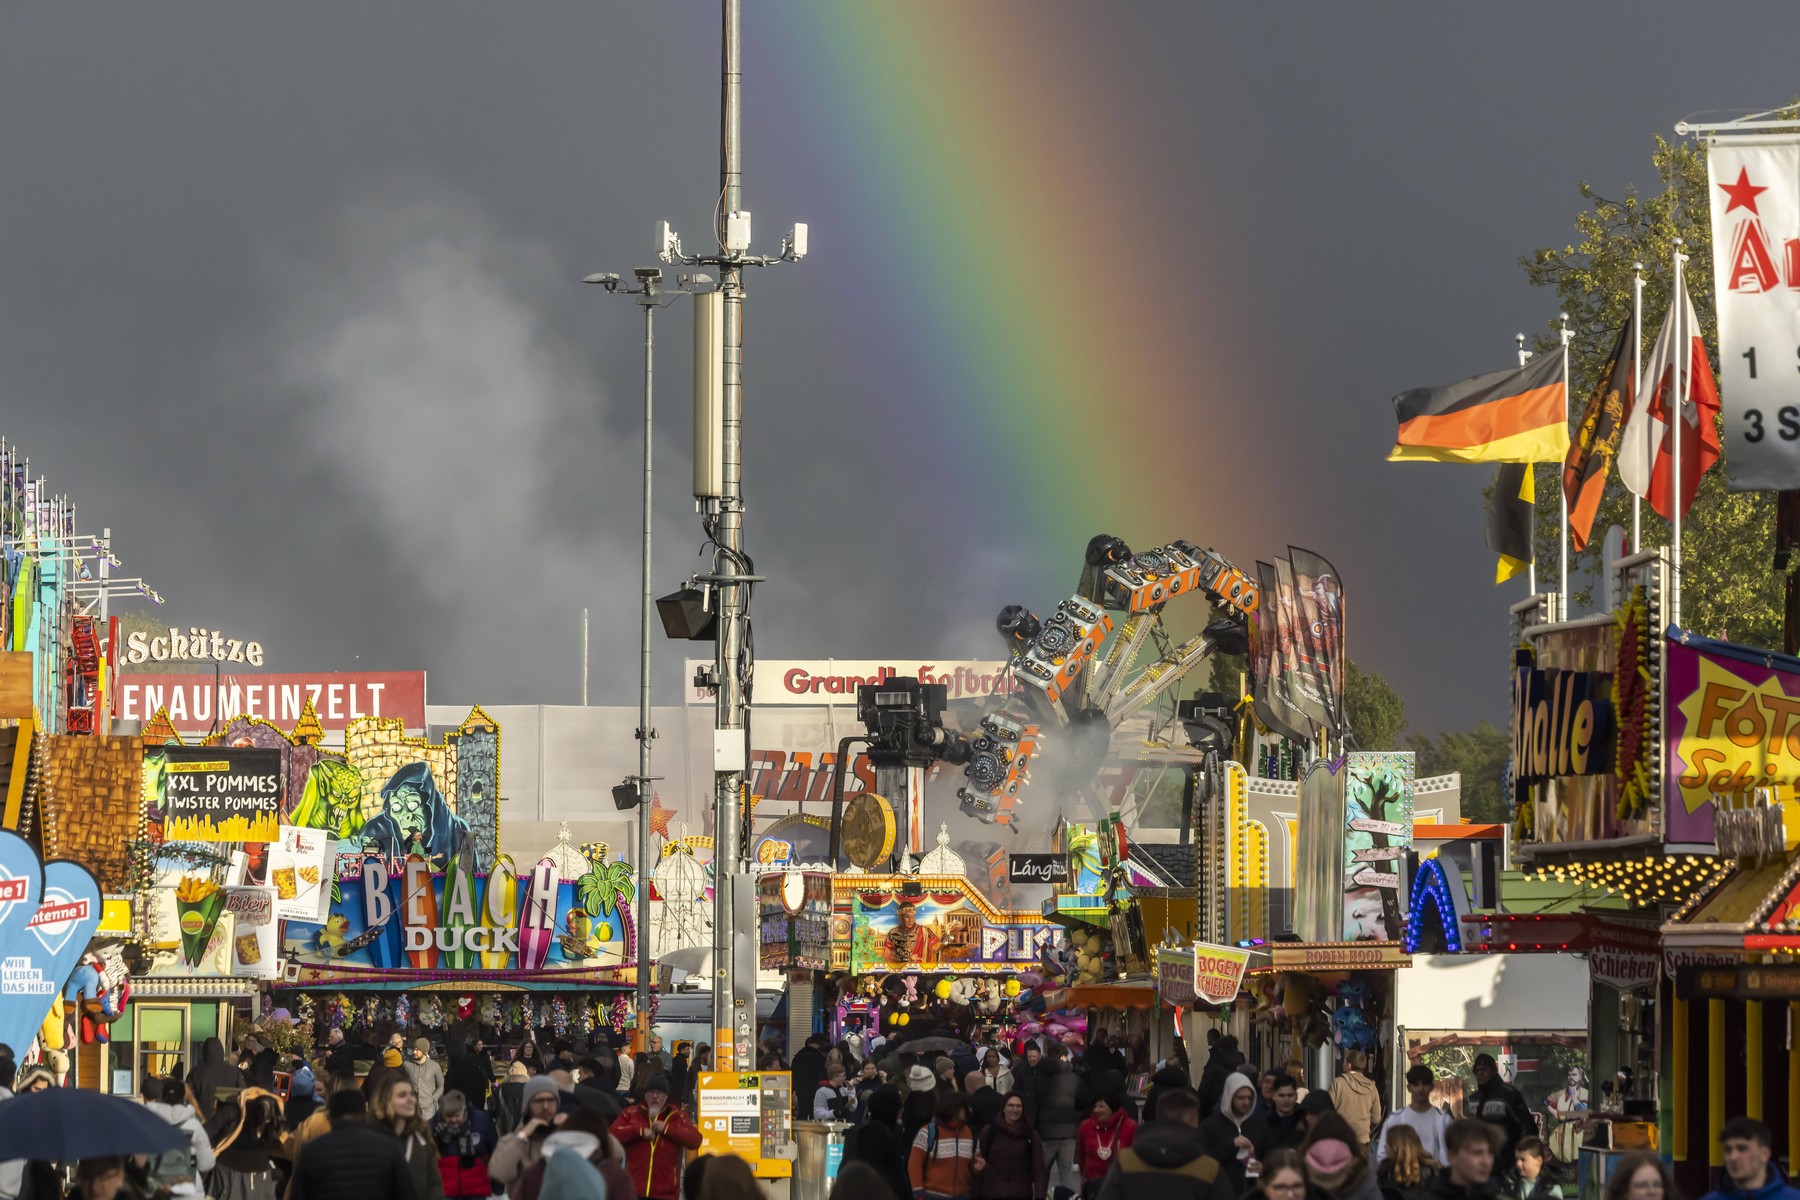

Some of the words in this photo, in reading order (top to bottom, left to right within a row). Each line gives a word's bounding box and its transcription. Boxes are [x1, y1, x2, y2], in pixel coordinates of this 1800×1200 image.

[1744, 409, 1765, 443] 3
[127, 627, 264, 667] Schütze
[167, 775, 199, 792] XXL
[206, 774, 278, 793] POMMES
[167, 796, 220, 810] TWISTER
[224, 796, 278, 810] POMMES
[1011, 858, 1067, 881] Láng
[226, 894, 269, 912] Bier
[363, 861, 559, 930] BEACH
[78, 903, 86, 916] 1
[404, 926, 519, 953] DUCK
[4, 959, 25, 968] WIR
[1305, 950, 1345, 964] ROBIN
[1350, 950, 1383, 964] HOOD
[4, 970, 40, 980] LIEBEN
[1198, 956, 1241, 979] BOGEN
[3, 982, 25, 992] DAS
[27, 983, 53, 992] HIER
[1197, 974, 1238, 998] SCHIESSEN
